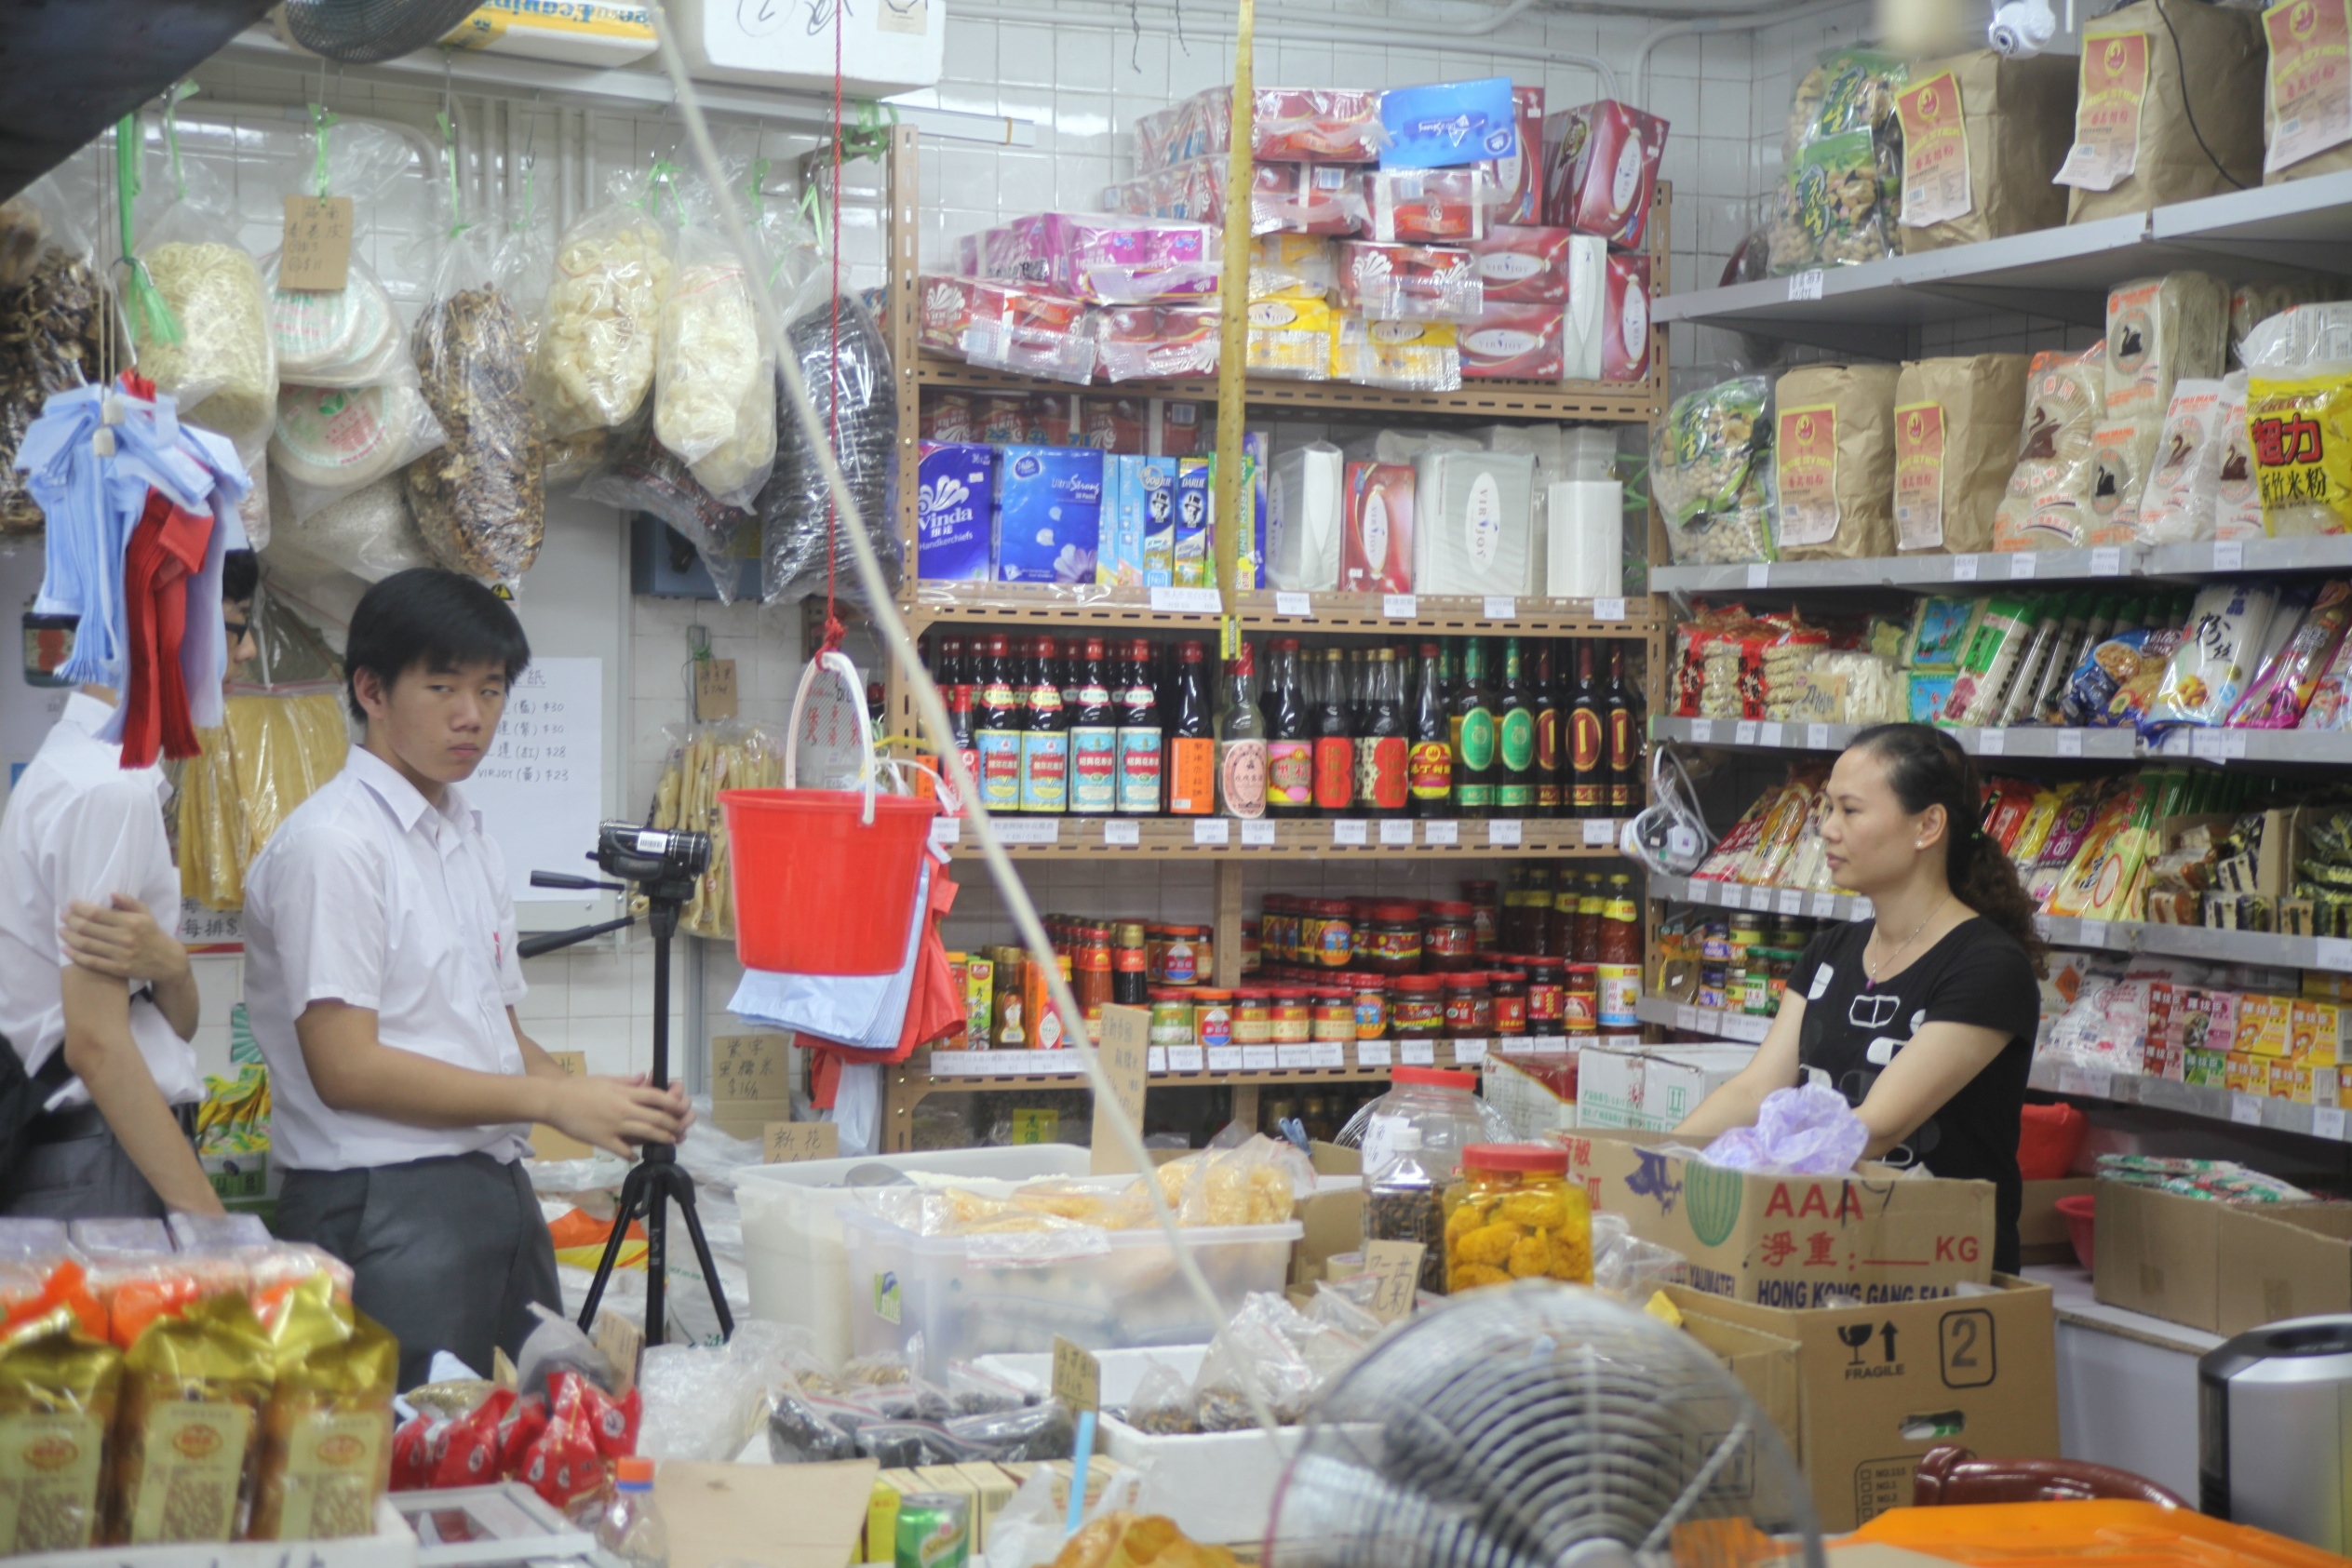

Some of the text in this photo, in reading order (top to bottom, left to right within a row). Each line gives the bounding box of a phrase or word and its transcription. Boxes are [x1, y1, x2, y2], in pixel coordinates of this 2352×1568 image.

[2251, 411, 2324, 467] 超力
[1181, 477, 1205, 489] DARLIE
[919, 508, 974, 531] Vinda
[543, 702, 564, 713] $30
[543, 724, 564, 735] $30
[546, 746, 566, 758] $28
[545, 768, 569, 782] $23
[1764, 1181, 1864, 1220] AAA
[1936, 1235, 1980, 1263] KG
[1758, 1280, 1808, 1307] HONG
[1867, 1283, 1914, 1305] GANG
[1950, 1317, 1978, 1368] 2
[1845, 1363, 1904, 1381] FRAGILE
